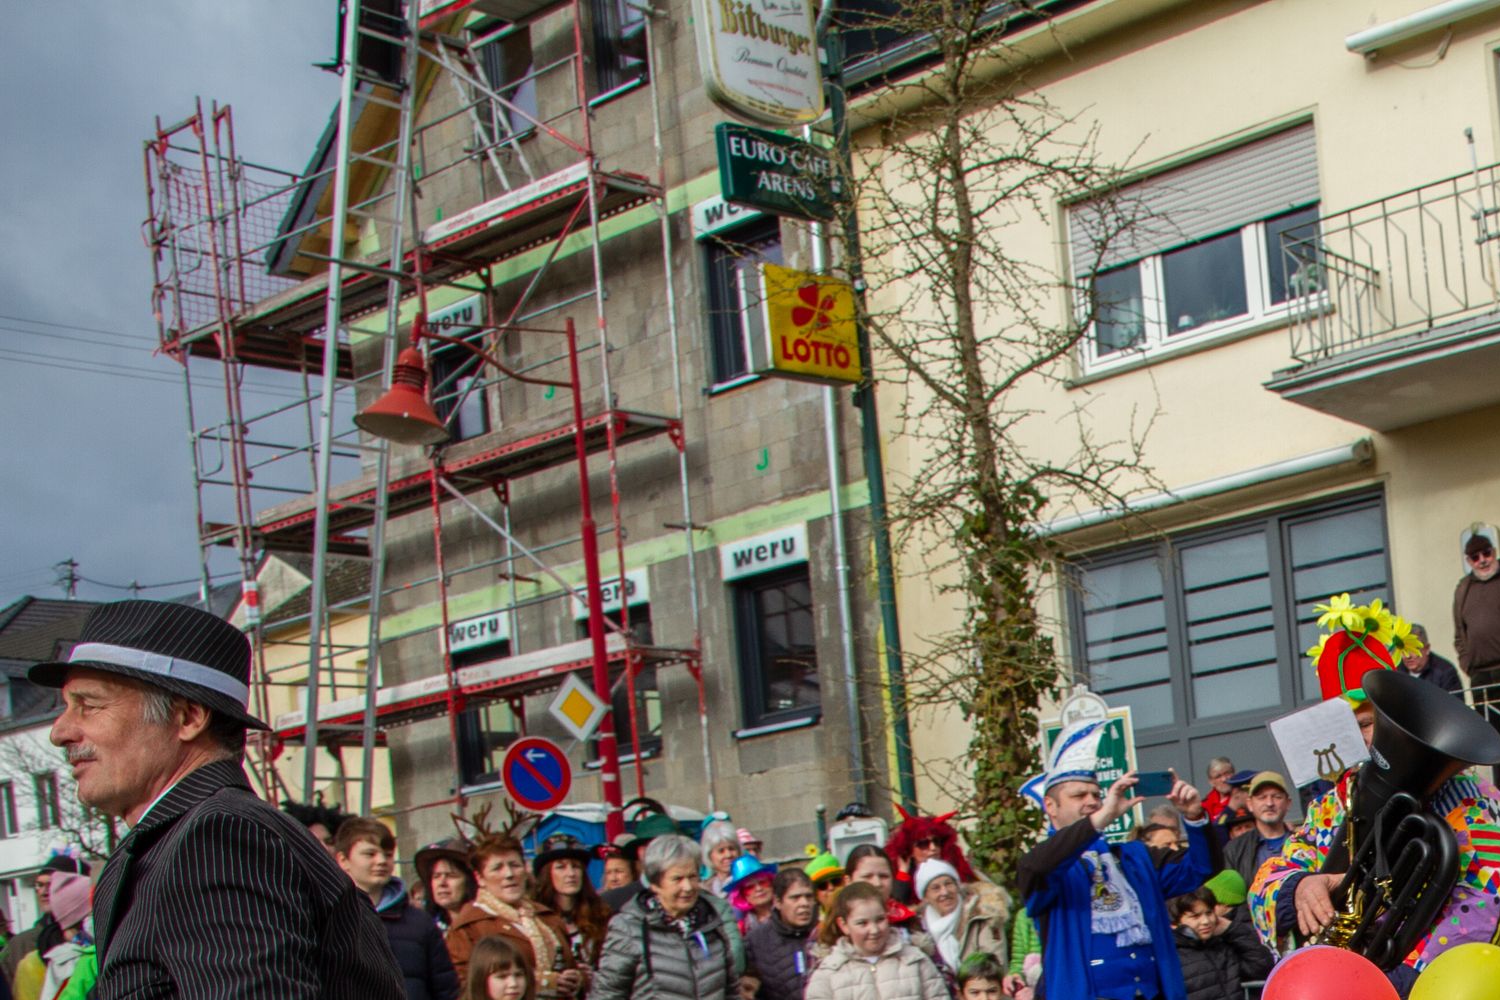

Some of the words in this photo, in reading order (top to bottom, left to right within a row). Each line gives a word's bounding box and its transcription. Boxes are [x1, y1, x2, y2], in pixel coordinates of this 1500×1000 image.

[729, 136, 787, 165] EURO
[758, 170, 815, 200] ARENS
[781, 335, 850, 369] LOTTO
[733, 536, 795, 568] weru
[450, 617, 498, 643] weru
